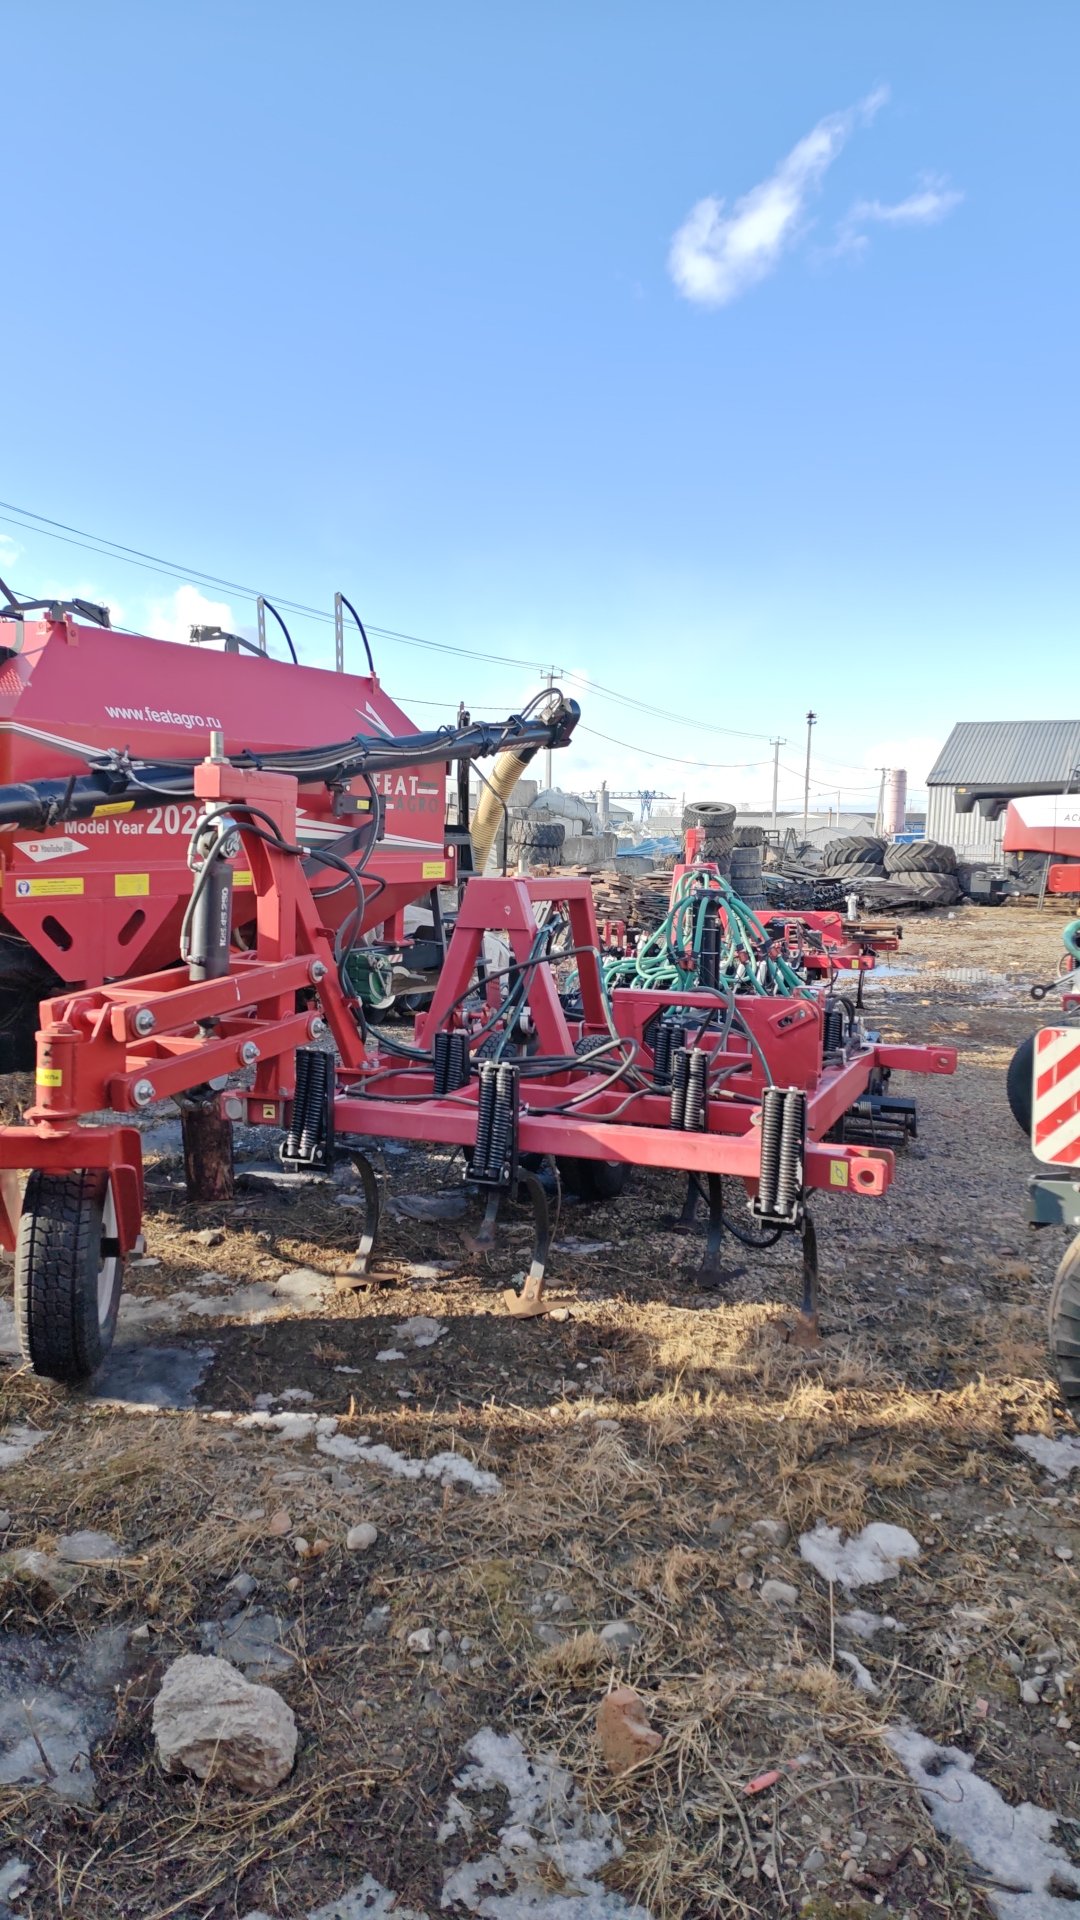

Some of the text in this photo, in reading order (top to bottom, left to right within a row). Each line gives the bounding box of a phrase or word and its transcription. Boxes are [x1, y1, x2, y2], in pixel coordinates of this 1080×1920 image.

[105, 706, 222, 729] www.featagro.ru
[373, 773, 419, 796] FEAT
[64, 820, 109, 834] Model
[113, 820, 144, 834] Year
[146, 805, 207, 835] 202
